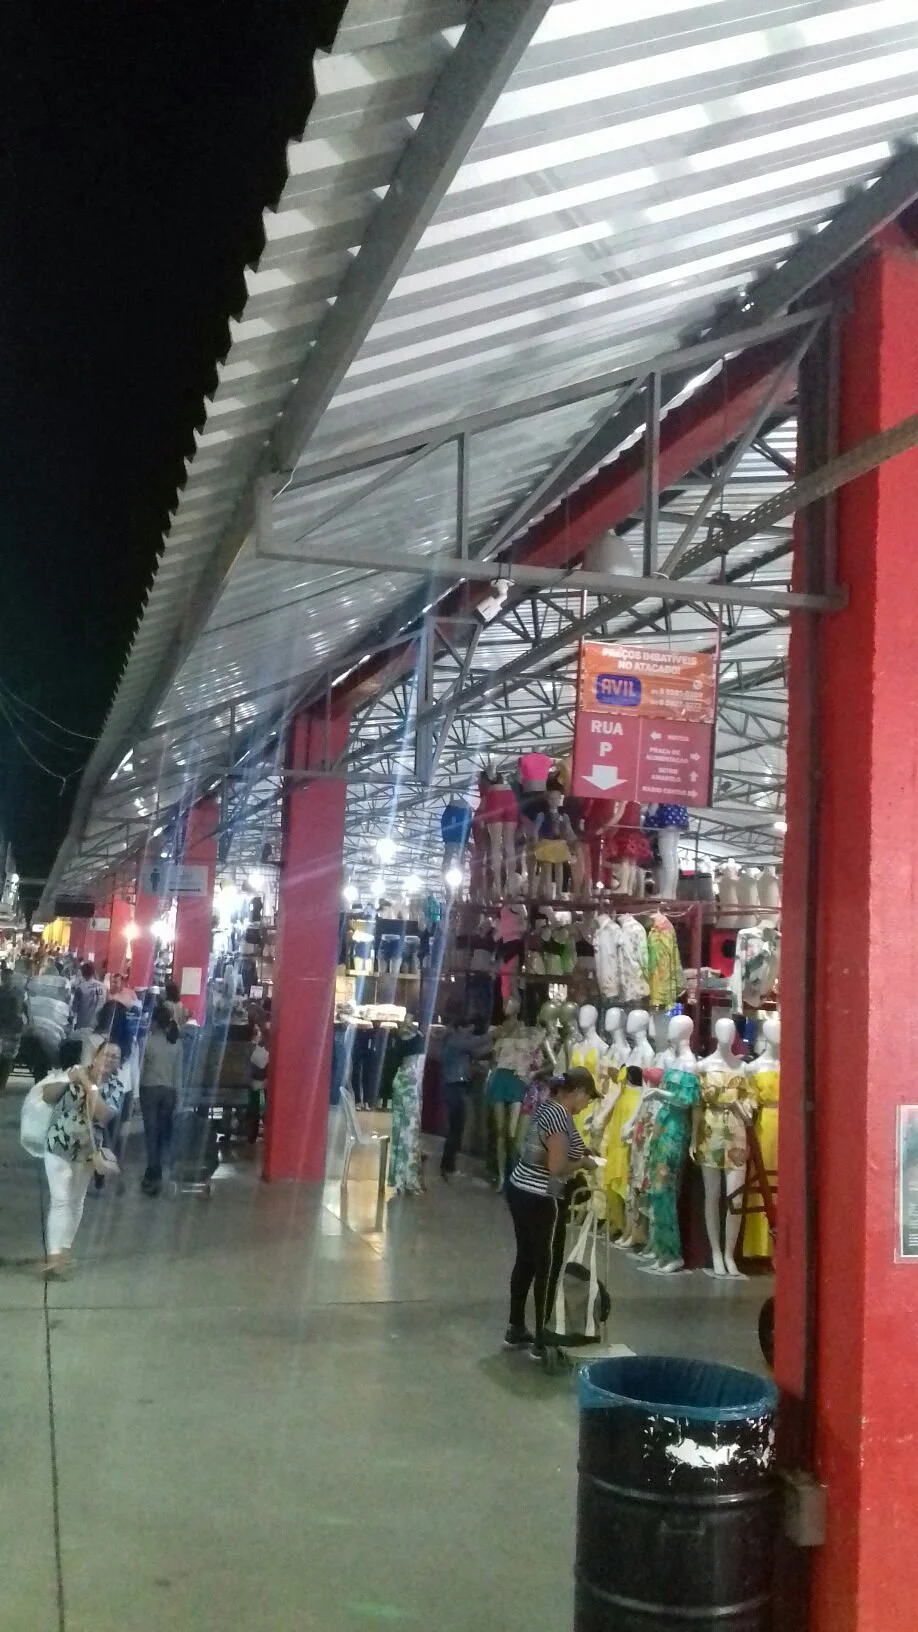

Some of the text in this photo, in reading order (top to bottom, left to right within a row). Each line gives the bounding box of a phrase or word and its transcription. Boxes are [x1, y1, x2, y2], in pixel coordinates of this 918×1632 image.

[618, 660, 632, 670] NO
[601, 679, 637, 697] AVIL
[591, 719, 624, 736] RUA
[600, 741, 613, 757] P
